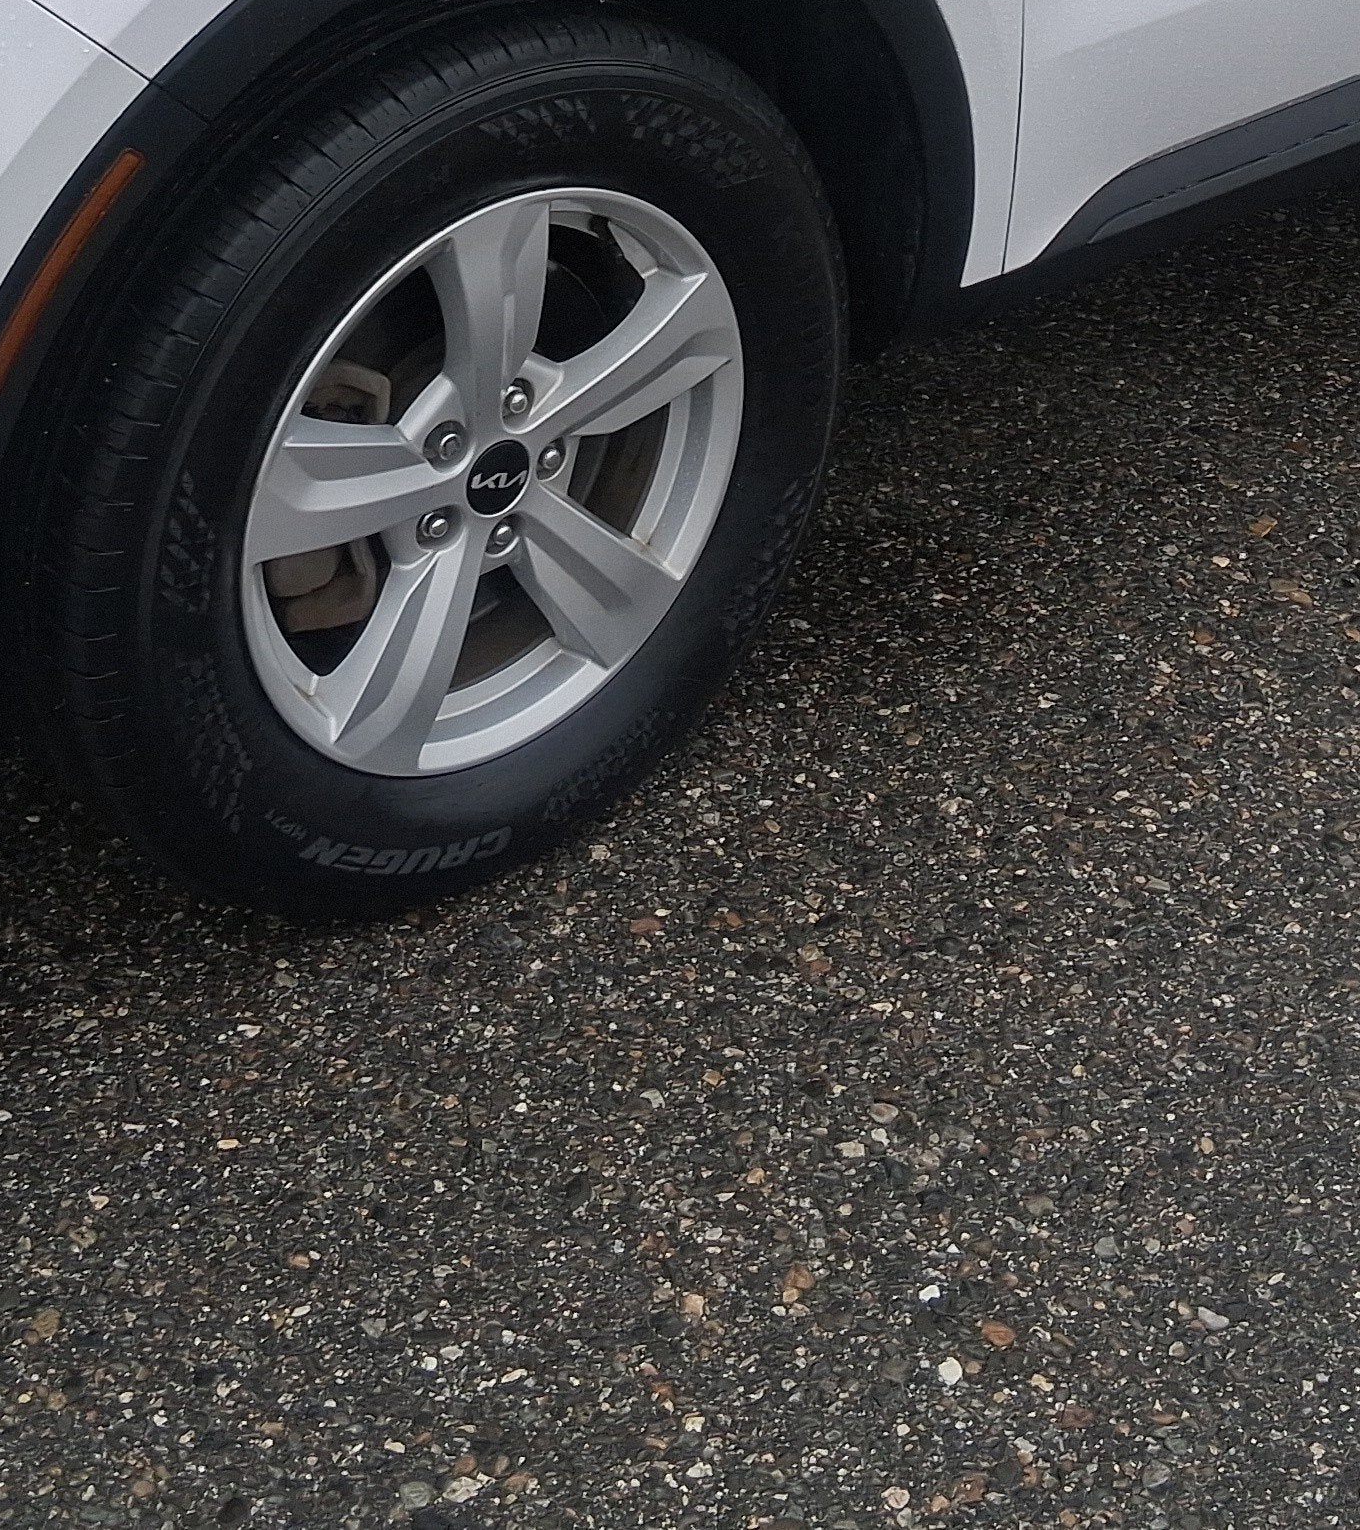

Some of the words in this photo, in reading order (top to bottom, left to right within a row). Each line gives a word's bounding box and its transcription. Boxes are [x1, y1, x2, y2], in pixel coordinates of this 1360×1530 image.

[470, 469, 528, 490] KIA
[262, 807, 309, 842] HP71
[298, 825, 513, 876] CRUGEN
